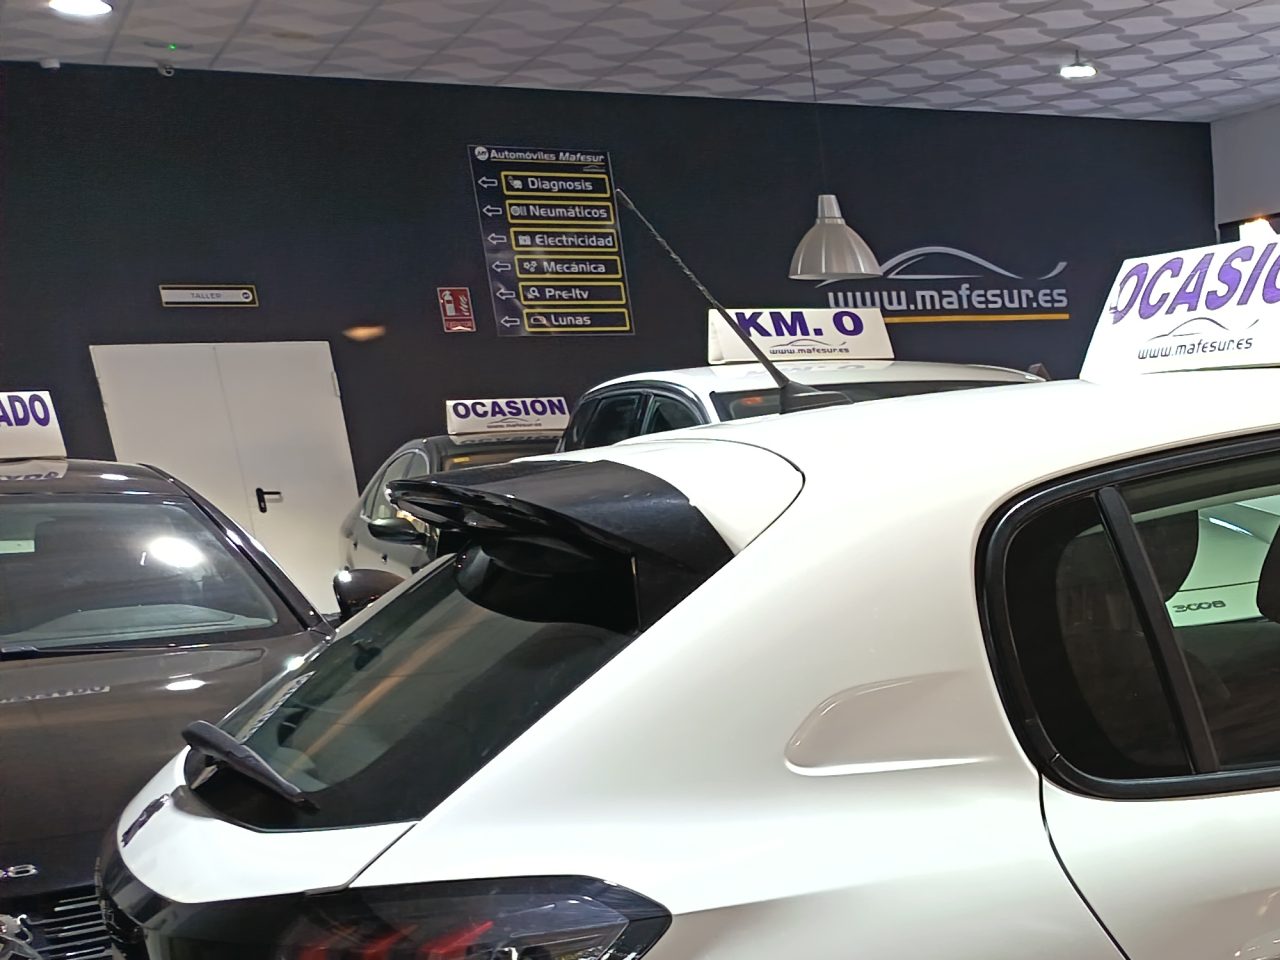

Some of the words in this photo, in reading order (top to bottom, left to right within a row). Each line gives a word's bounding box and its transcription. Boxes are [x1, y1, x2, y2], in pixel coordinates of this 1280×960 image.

[490, 150, 556, 161] Automóviles
[559, 152, 605, 162] Mafesur
[528, 177, 593, 192] Diagnosis
[530, 204, 608, 218] Neumáticos
[535, 234, 613, 247] Electricidad
[543, 261, 606, 273] Mecánica
[828, 283, 1068, 311] www.mafesur.es
[551, 313, 592, 325] Lunas
[769, 346, 850, 355] www.mafesur.es
[1138, 337, 1253, 360] www.mafesur.es
[453, 399, 566, 419] OCASION
[1172, 600, 1226, 613] 3008
